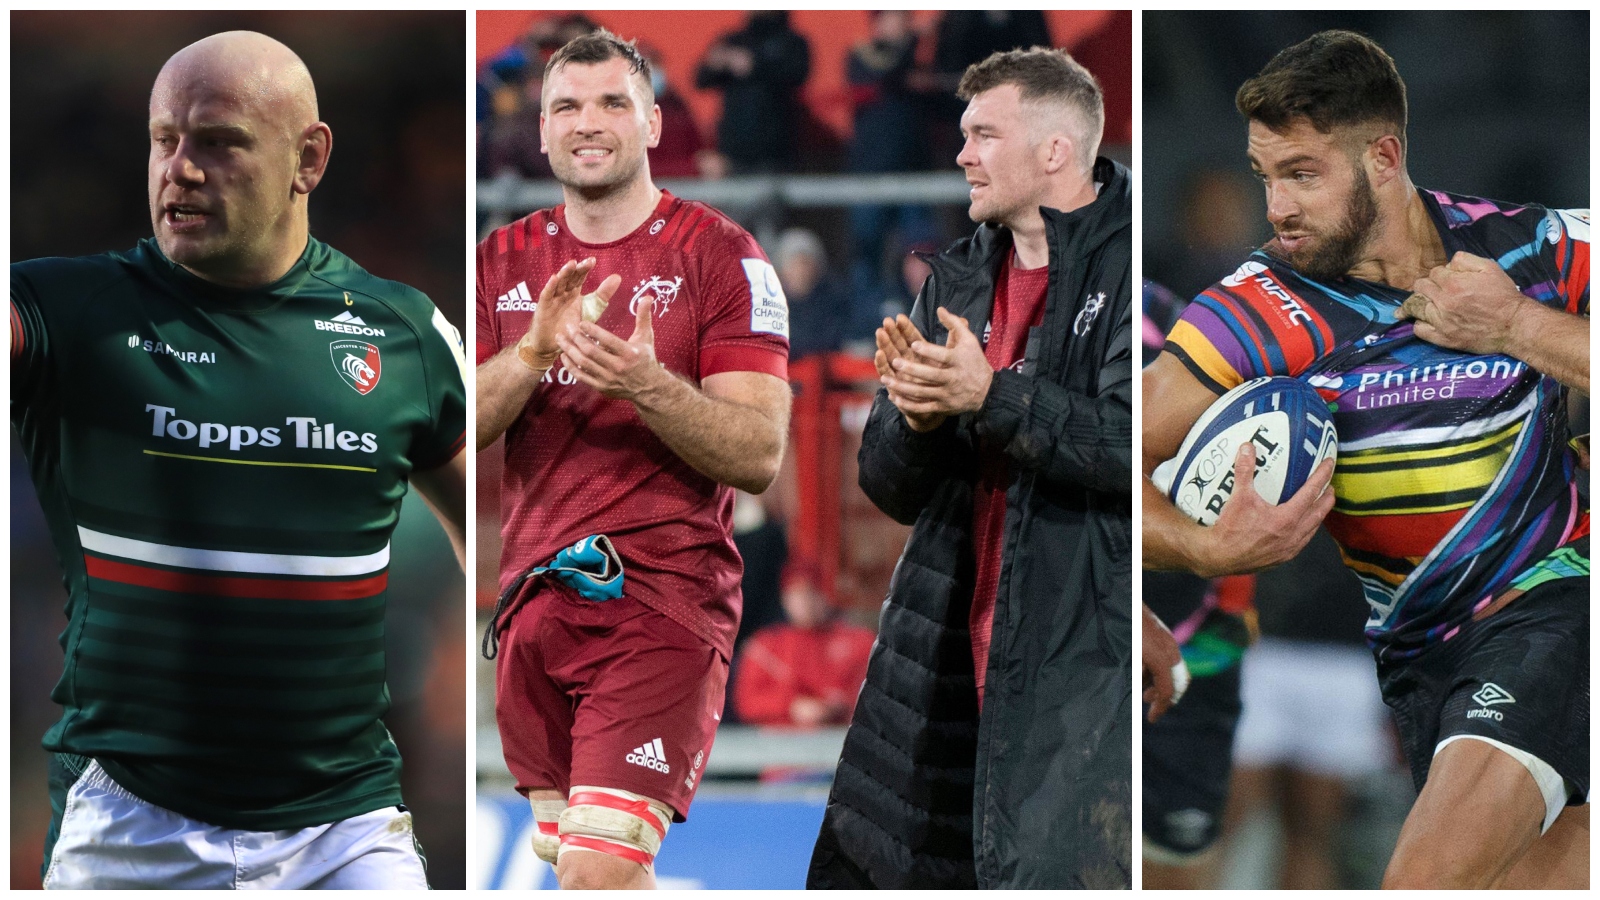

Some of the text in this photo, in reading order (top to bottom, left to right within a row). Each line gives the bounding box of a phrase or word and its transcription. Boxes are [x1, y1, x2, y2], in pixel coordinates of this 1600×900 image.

[1255, 276, 1312, 326] NPTC
[314, 319, 386, 337] BREEDON
[143, 339, 217, 364] SAMURAI
[359, 345, 377, 354] TIGERS
[1358, 360, 1524, 393] Philtroni
[1356, 381, 1455, 410] Limited
[145, 404, 379, 454] Topps Tiles
[1466, 707, 1504, 722] umbro
[625, 752, 670, 775] adidas
